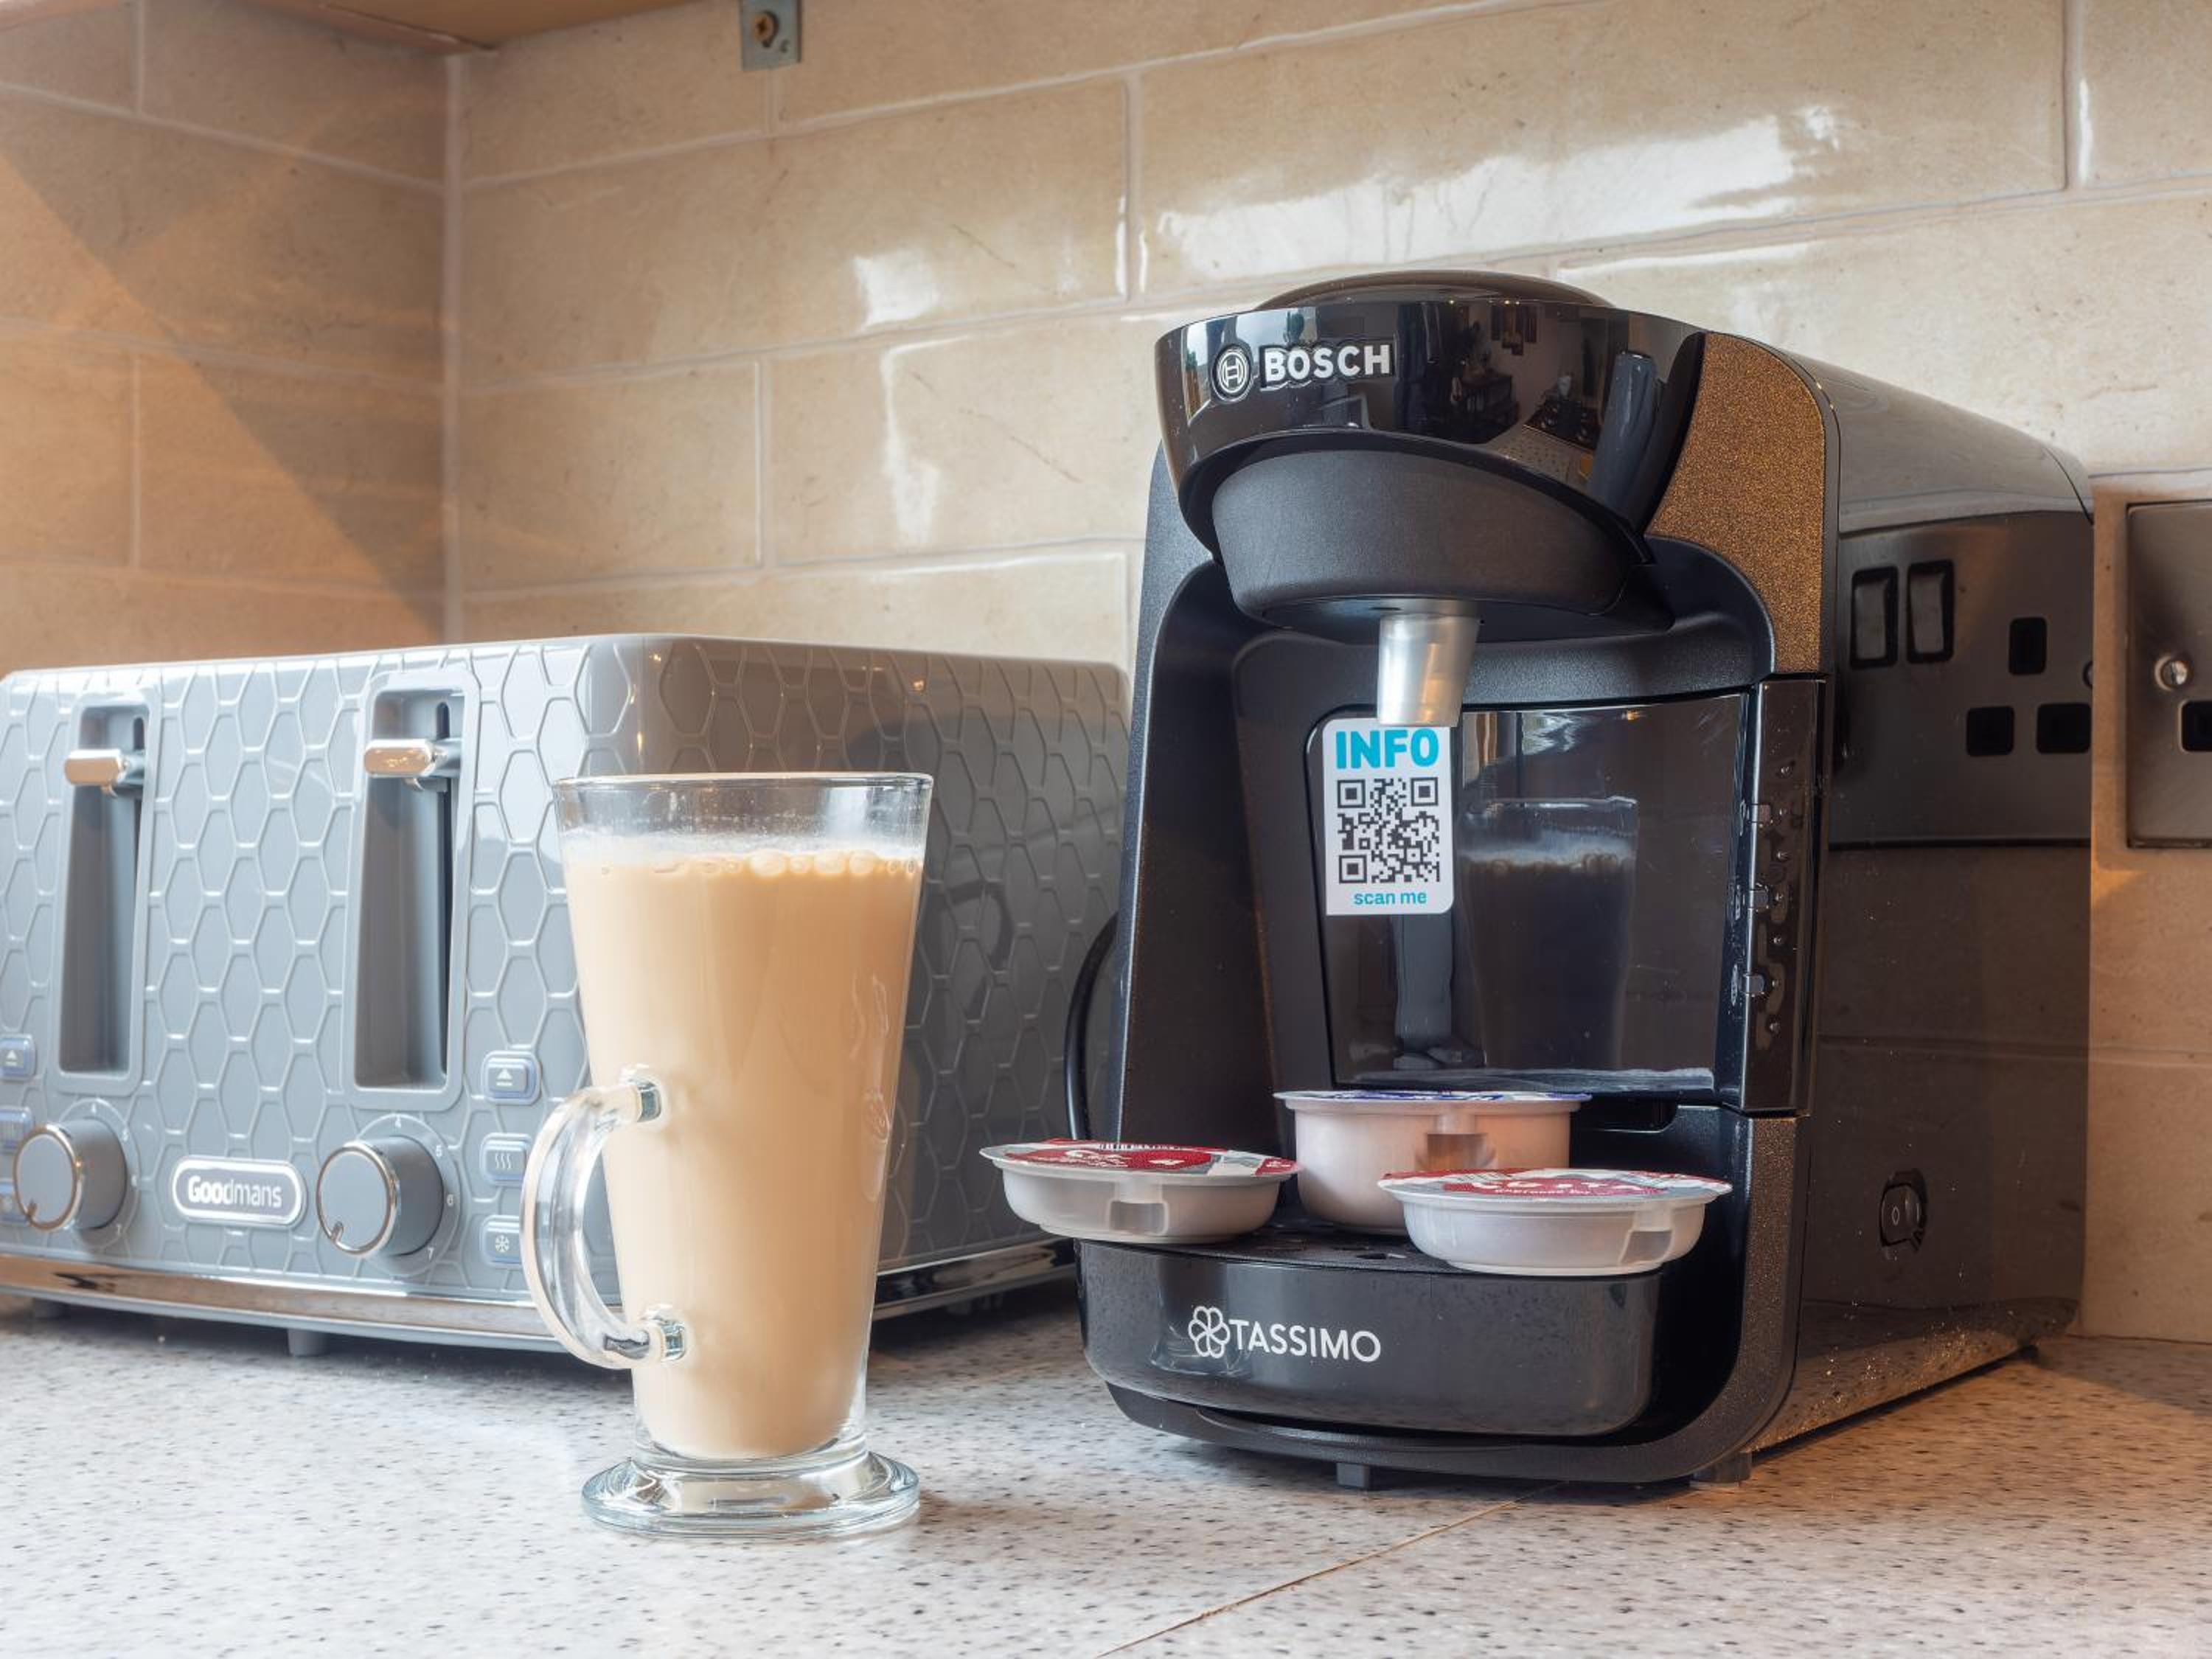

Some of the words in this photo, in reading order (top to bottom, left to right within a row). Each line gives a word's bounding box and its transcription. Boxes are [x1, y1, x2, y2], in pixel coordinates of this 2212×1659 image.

[1265, 344, 1391, 382] BOSCH
[1335, 728, 1439, 769] INFO
[1353, 893, 1396, 905] scan
[1401, 891, 1427, 905] me
[187, 1175, 282, 1208] Goodmans
[1228, 1318, 1382, 1363] TASSIMO
